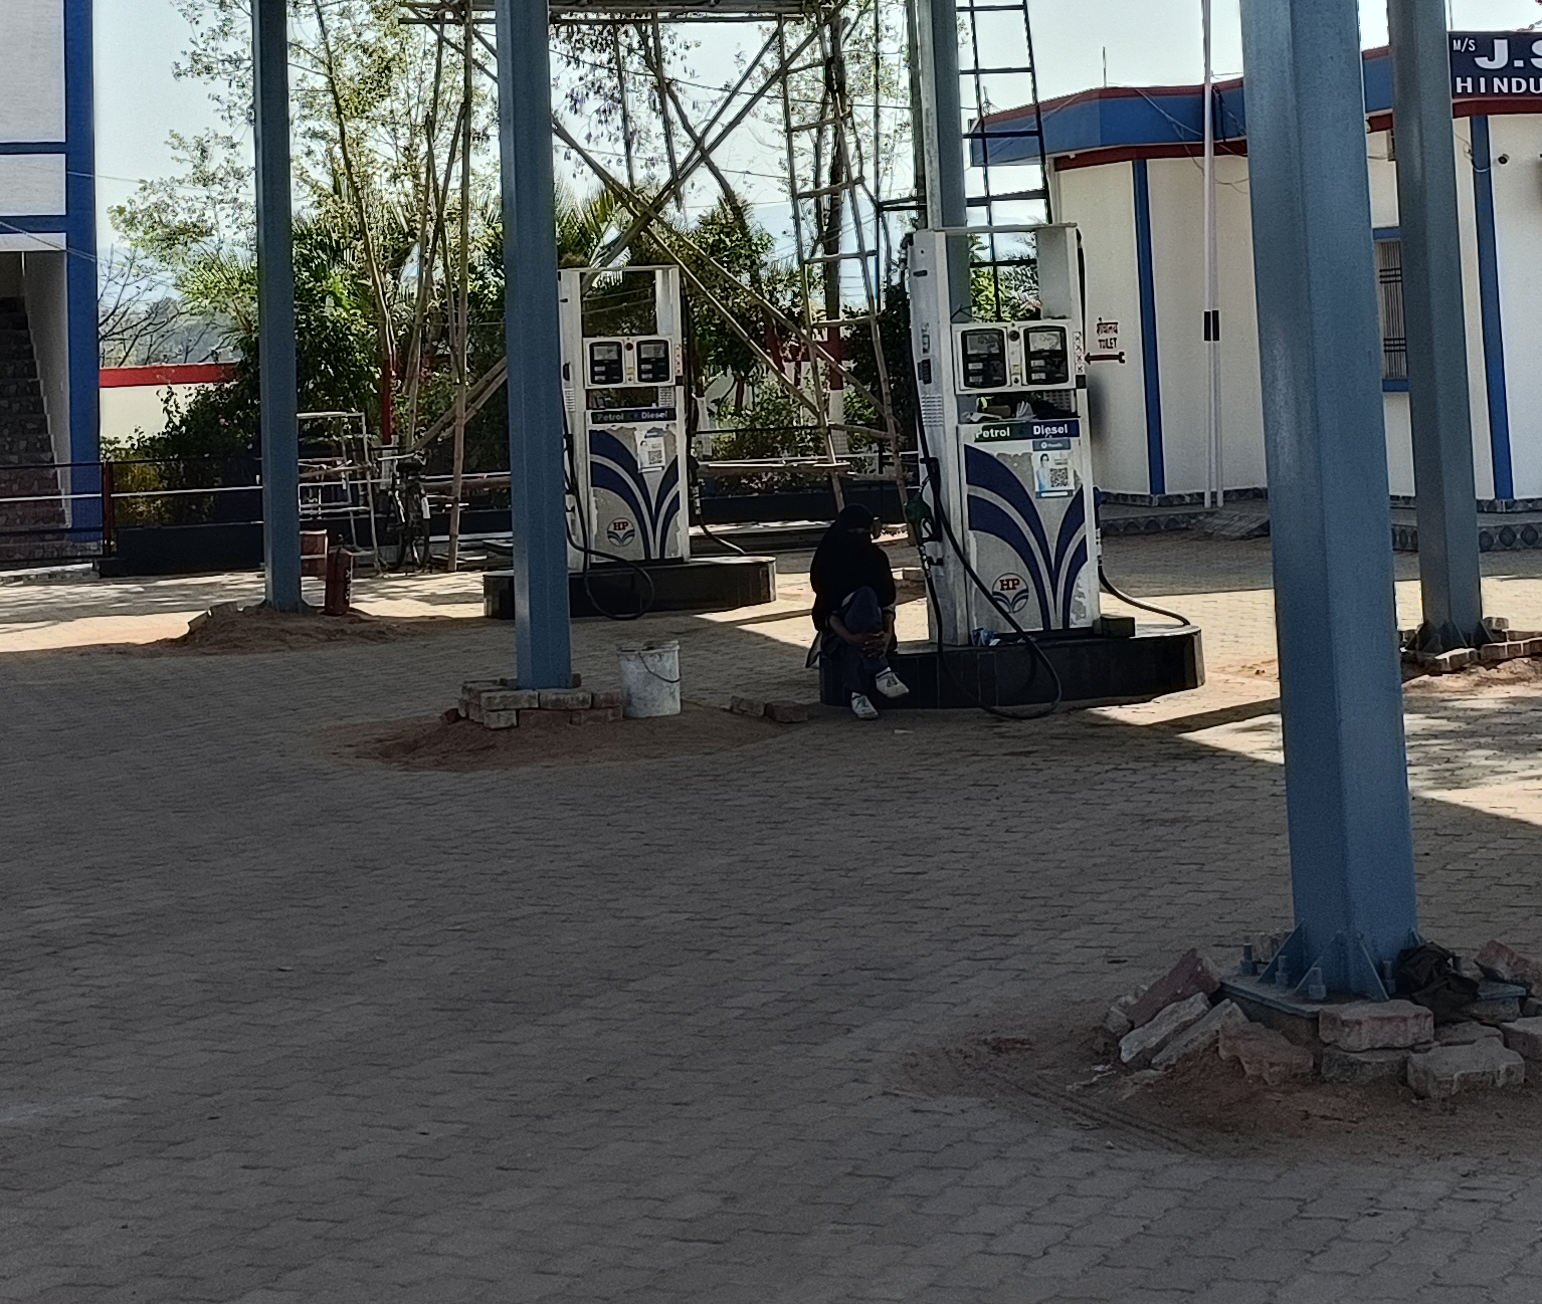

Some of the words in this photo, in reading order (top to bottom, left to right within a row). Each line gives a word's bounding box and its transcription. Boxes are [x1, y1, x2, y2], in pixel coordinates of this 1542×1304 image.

[1453, 37, 1476, 52] M/S
[596, 412, 625, 421] Petrol
[641, 410, 668, 419] Diesel
[975, 427, 1011, 439] Petrol
[1032, 424, 1068, 436] Diesel
[612, 521, 629, 531] HP
[999, 578, 1020, 591] HP
